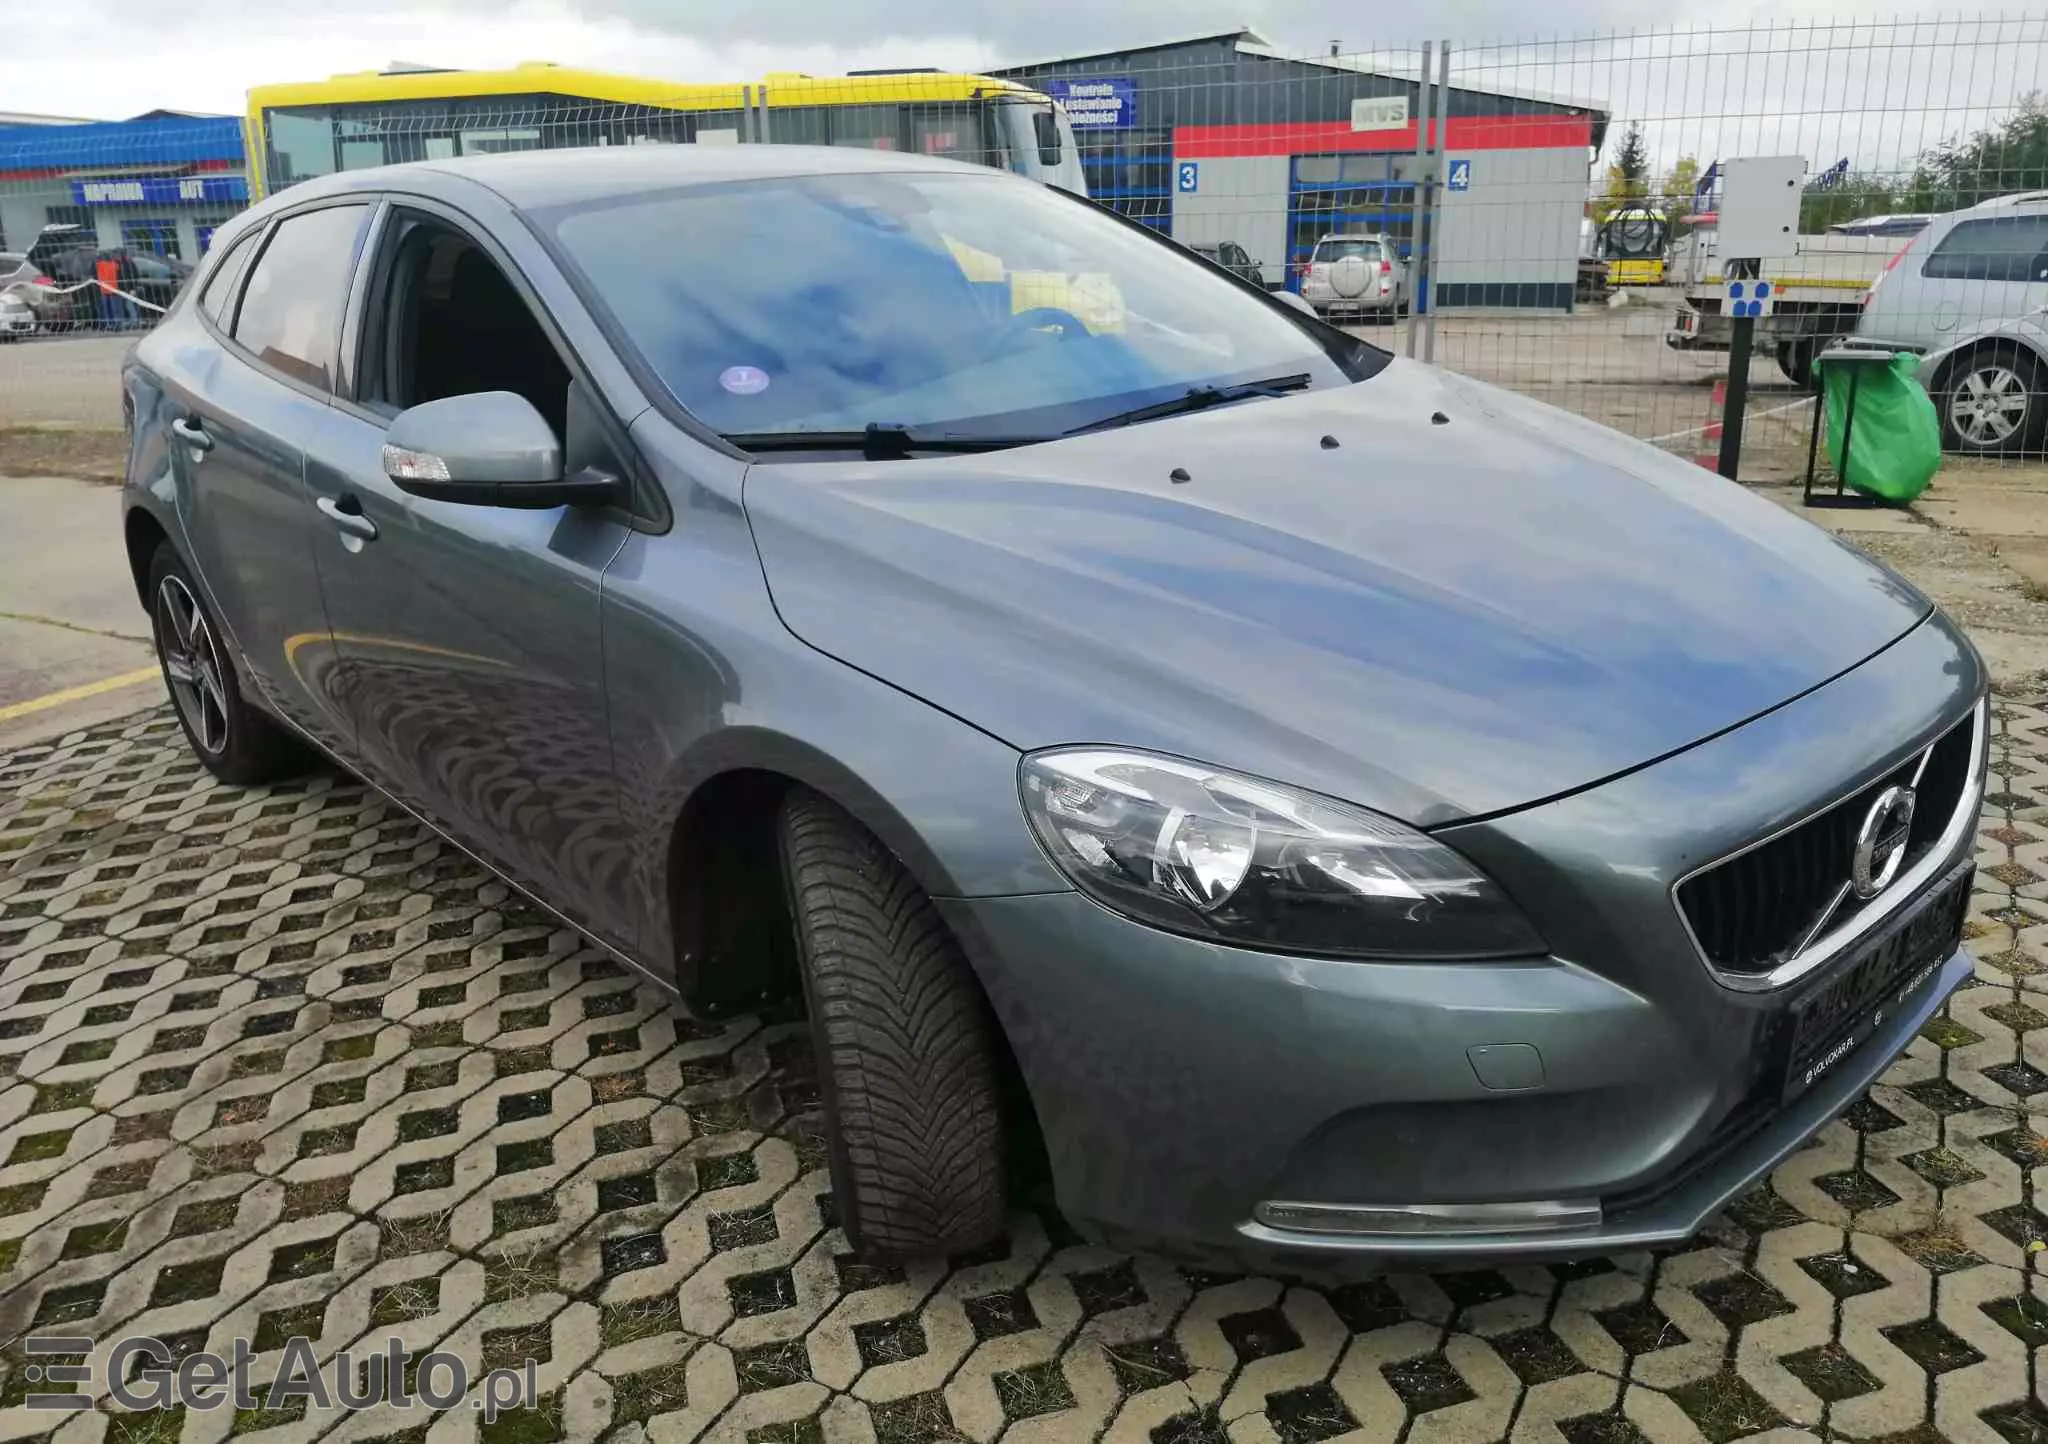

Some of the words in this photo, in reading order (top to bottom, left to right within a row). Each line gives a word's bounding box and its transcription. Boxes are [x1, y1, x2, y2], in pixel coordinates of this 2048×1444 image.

[1070, 110, 1118, 124] bieżności
[1181, 166, 1195, 189] 3
[1451, 163, 1469, 187] 4
